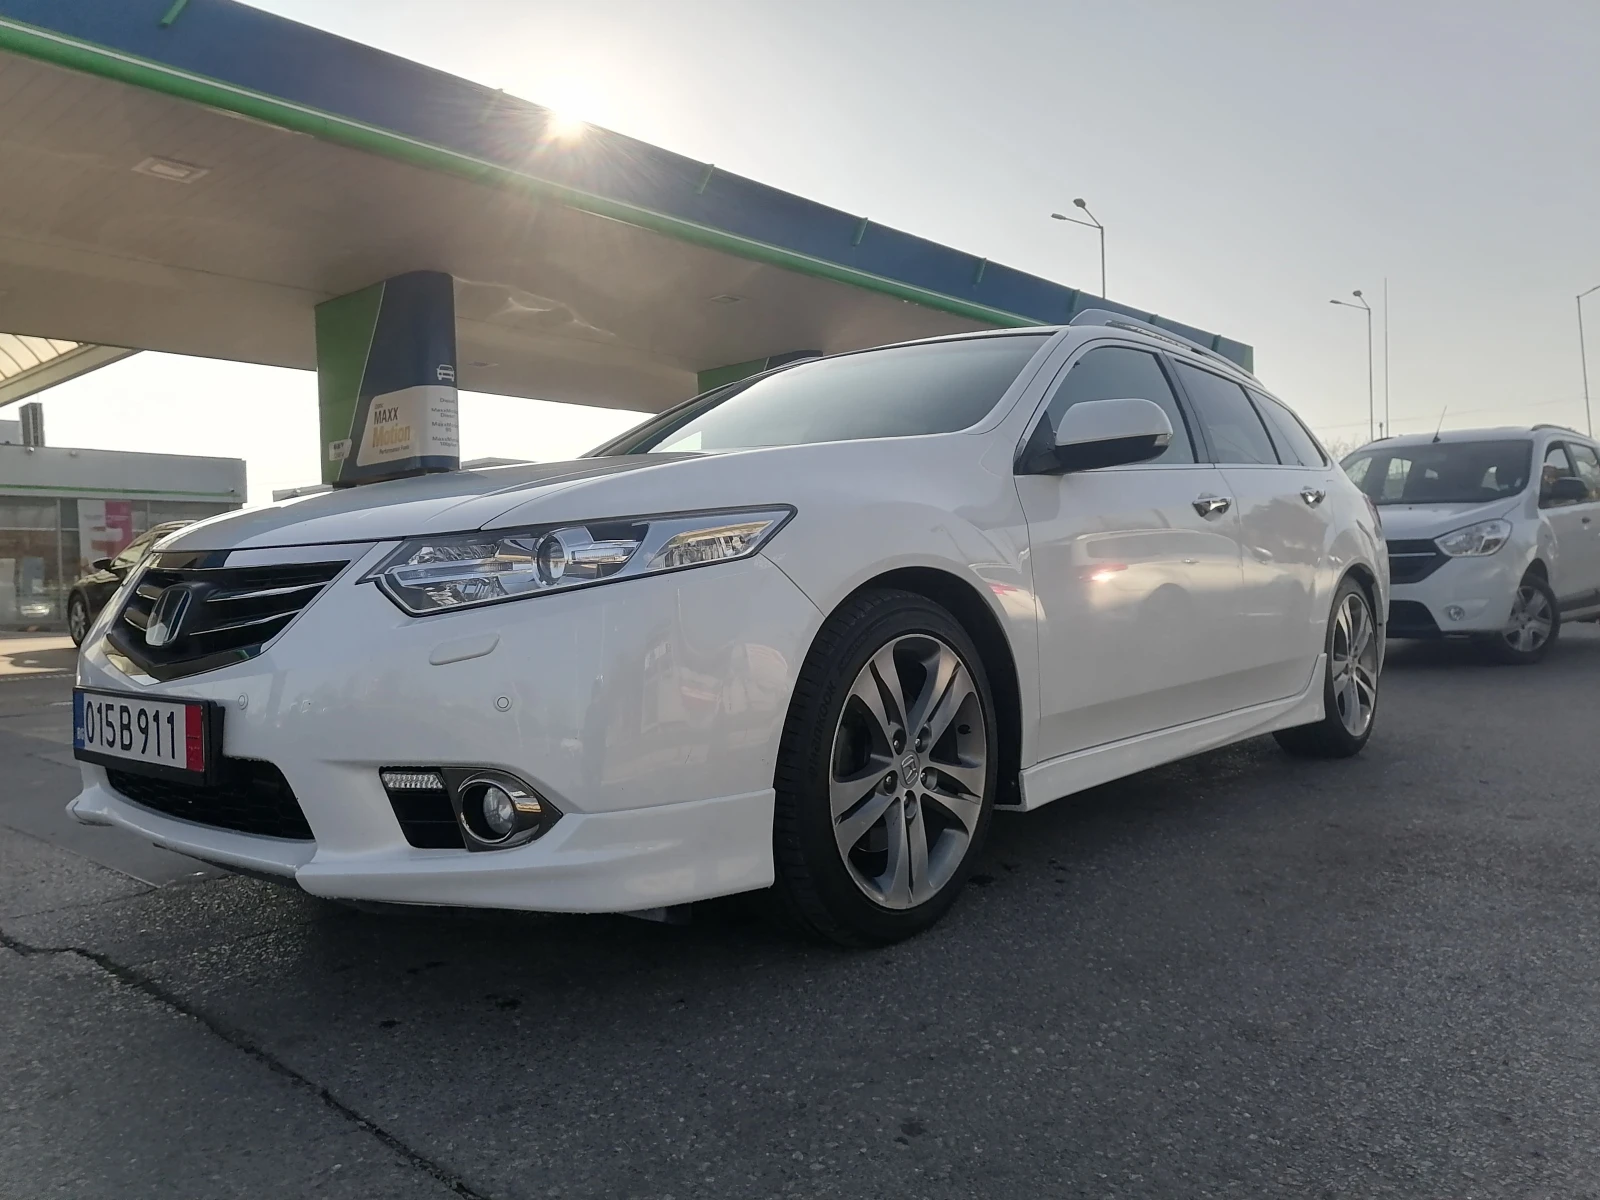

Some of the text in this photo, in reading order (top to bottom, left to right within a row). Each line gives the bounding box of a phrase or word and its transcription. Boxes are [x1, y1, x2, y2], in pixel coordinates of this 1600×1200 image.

[374, 406, 399, 425] MAXX
[372, 423, 411, 448] Motion
[86, 701, 175, 760] 015B911
